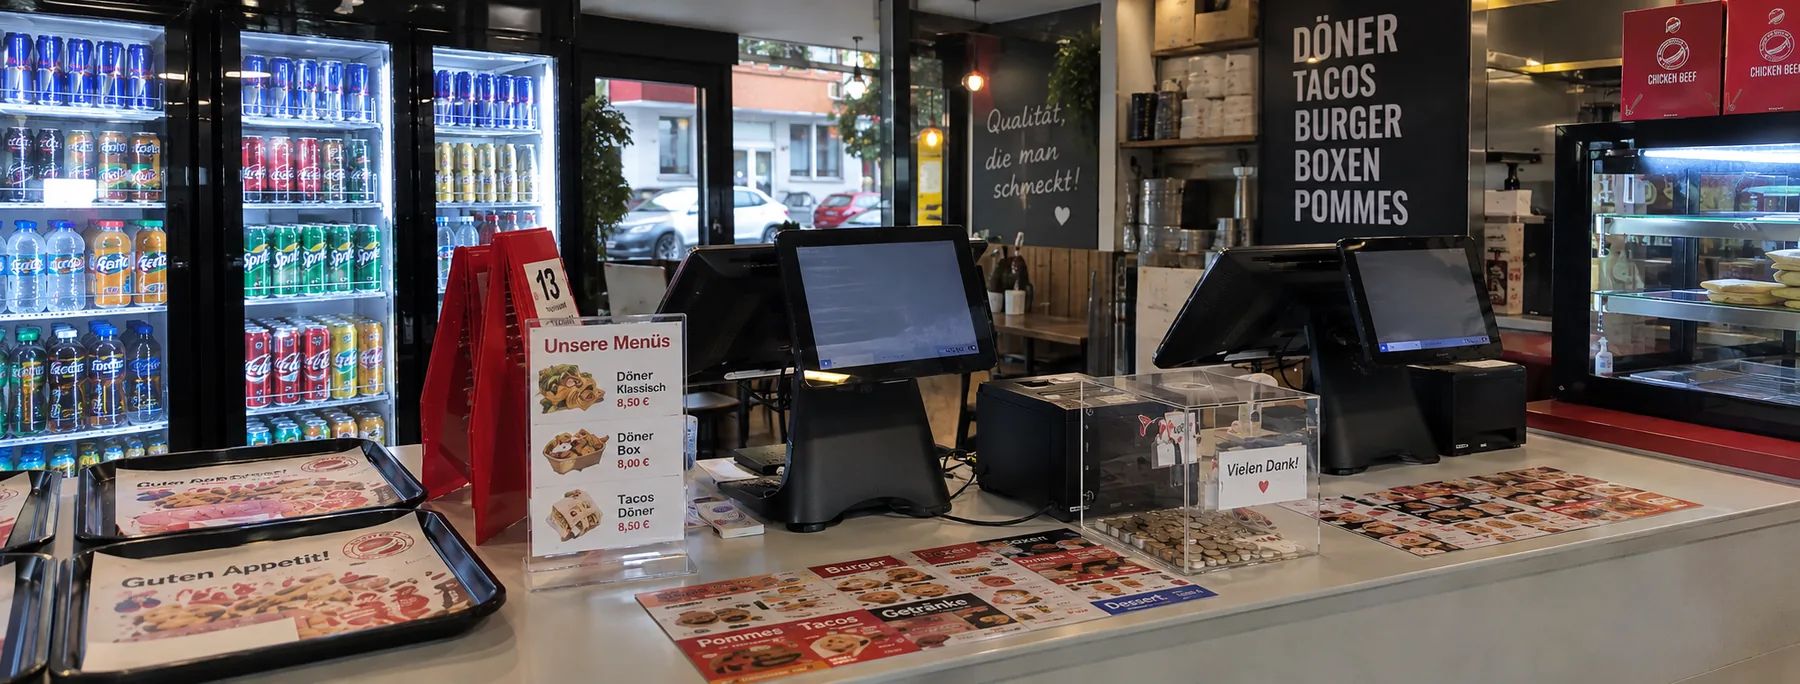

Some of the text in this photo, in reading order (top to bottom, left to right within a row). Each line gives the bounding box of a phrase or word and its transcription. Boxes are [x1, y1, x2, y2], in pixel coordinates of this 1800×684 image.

[1293, 13, 1398, 63] DÖNER
[1647, 71, 1697, 85] CHICKEN BEEF
[1750, 64, 1782, 78] CHICKEN
[1293, 63, 1376, 102] TACOS
[1295, 103, 1402, 142] BURGER
[985, 146, 1059, 170] die man
[1295, 147, 1380, 182] BOXEN
[993, 167, 1081, 199] schmeckt!
[1294, 189, 1409, 225] POMMES
[536, 268, 560, 301] 13
[544, 334, 670, 354] Unsere Menüs
[616, 371, 653, 382] Döner
[616, 383, 666, 394] Klassisch
[617, 396, 649, 409] 8,50 €
[617, 432, 654, 443] Döner
[617, 445, 641, 456] Box
[617, 457, 650, 470] 8,00 €
[1227, 456, 1299, 477] Vielen Dank!
[617, 493, 655, 505] Tacos
[617, 507, 655, 519] Döner
[617, 519, 650, 533] 8,50 €
[121, 550, 330, 589] Guten Appetit!
[824, 558, 887, 575] Burger
[881, 598, 968, 619] Getränke
[797, 616, 858, 631] Tacos
[697, 627, 783, 648] Pommes
